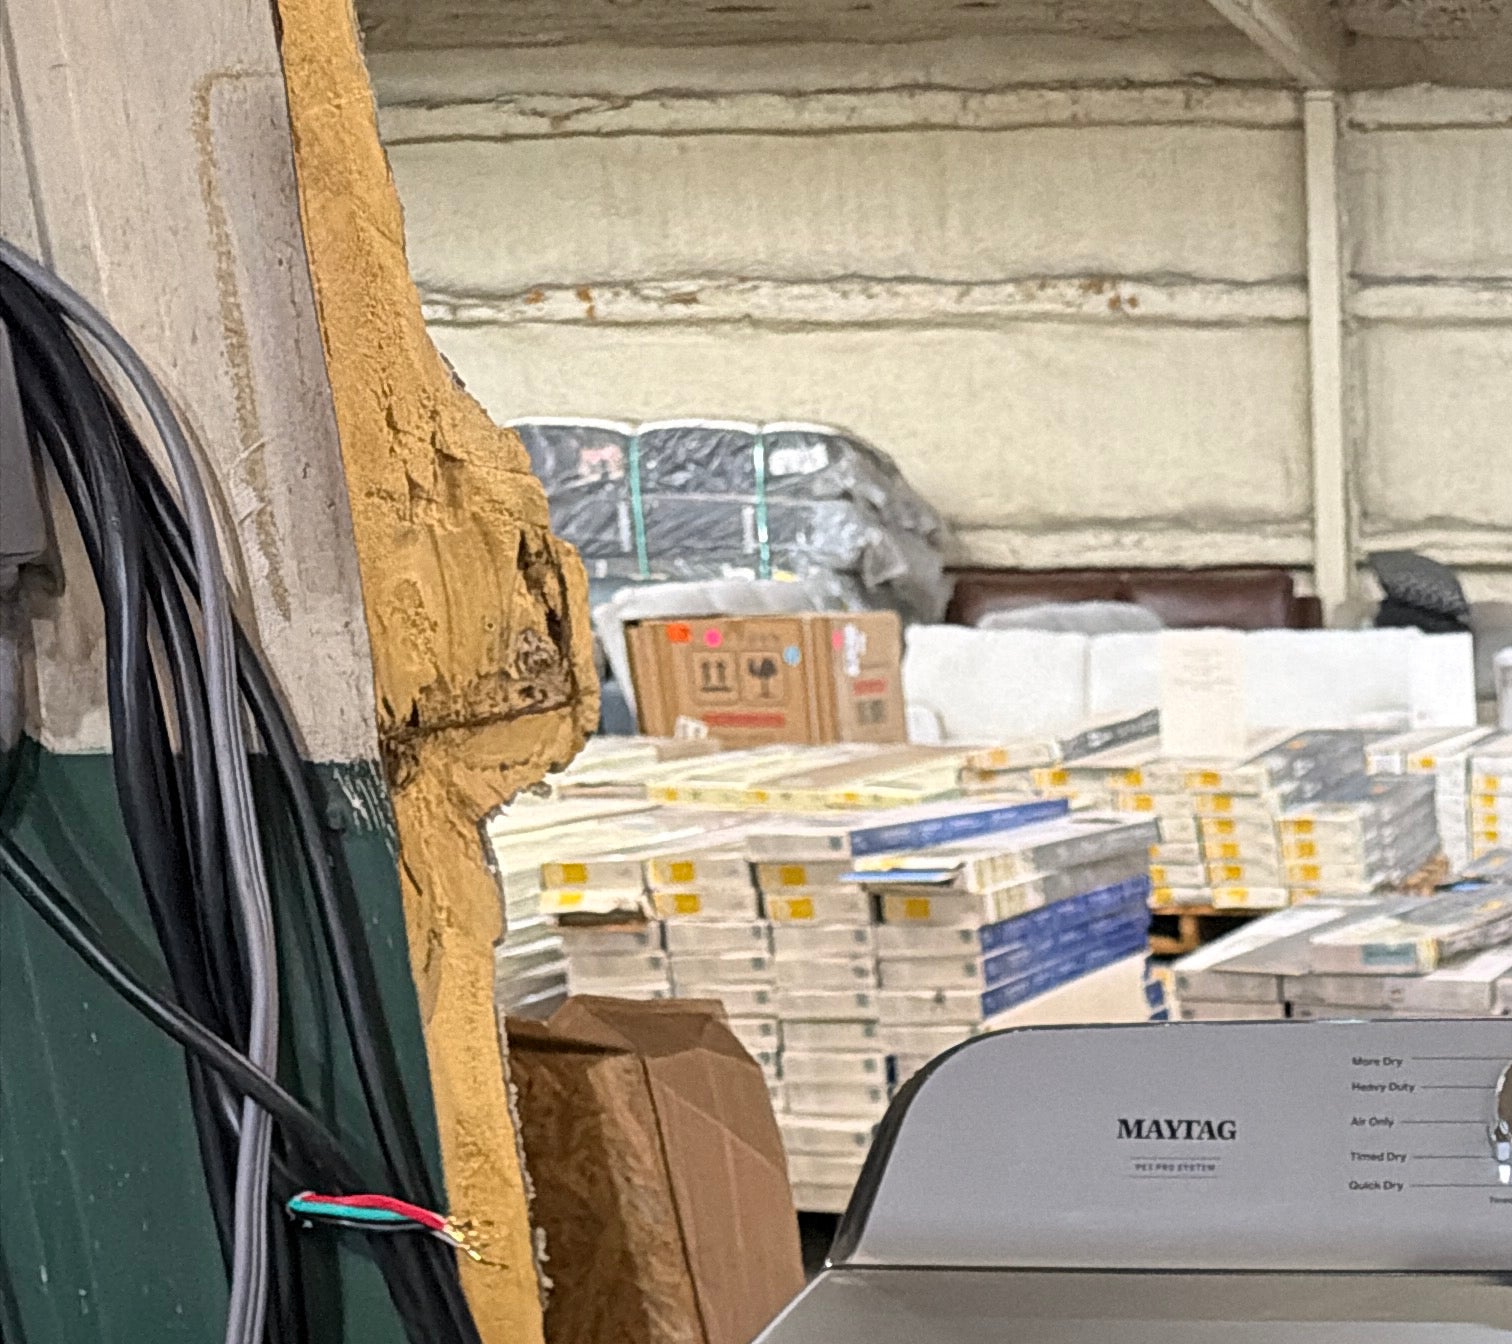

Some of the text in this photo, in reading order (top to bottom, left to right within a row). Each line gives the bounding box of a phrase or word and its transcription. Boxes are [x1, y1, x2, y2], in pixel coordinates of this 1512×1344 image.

[1351, 1056, 1403, 1068] More Dry
[1351, 1081, 1416, 1093] Heavy Duty
[1350, 1116, 1394, 1128] Air Only
[1117, 1118, 1237, 1140] MAYTAG
[1350, 1151, 1407, 1163] Timed Dry
[1348, 1180, 1404, 1192] Quick Dry
